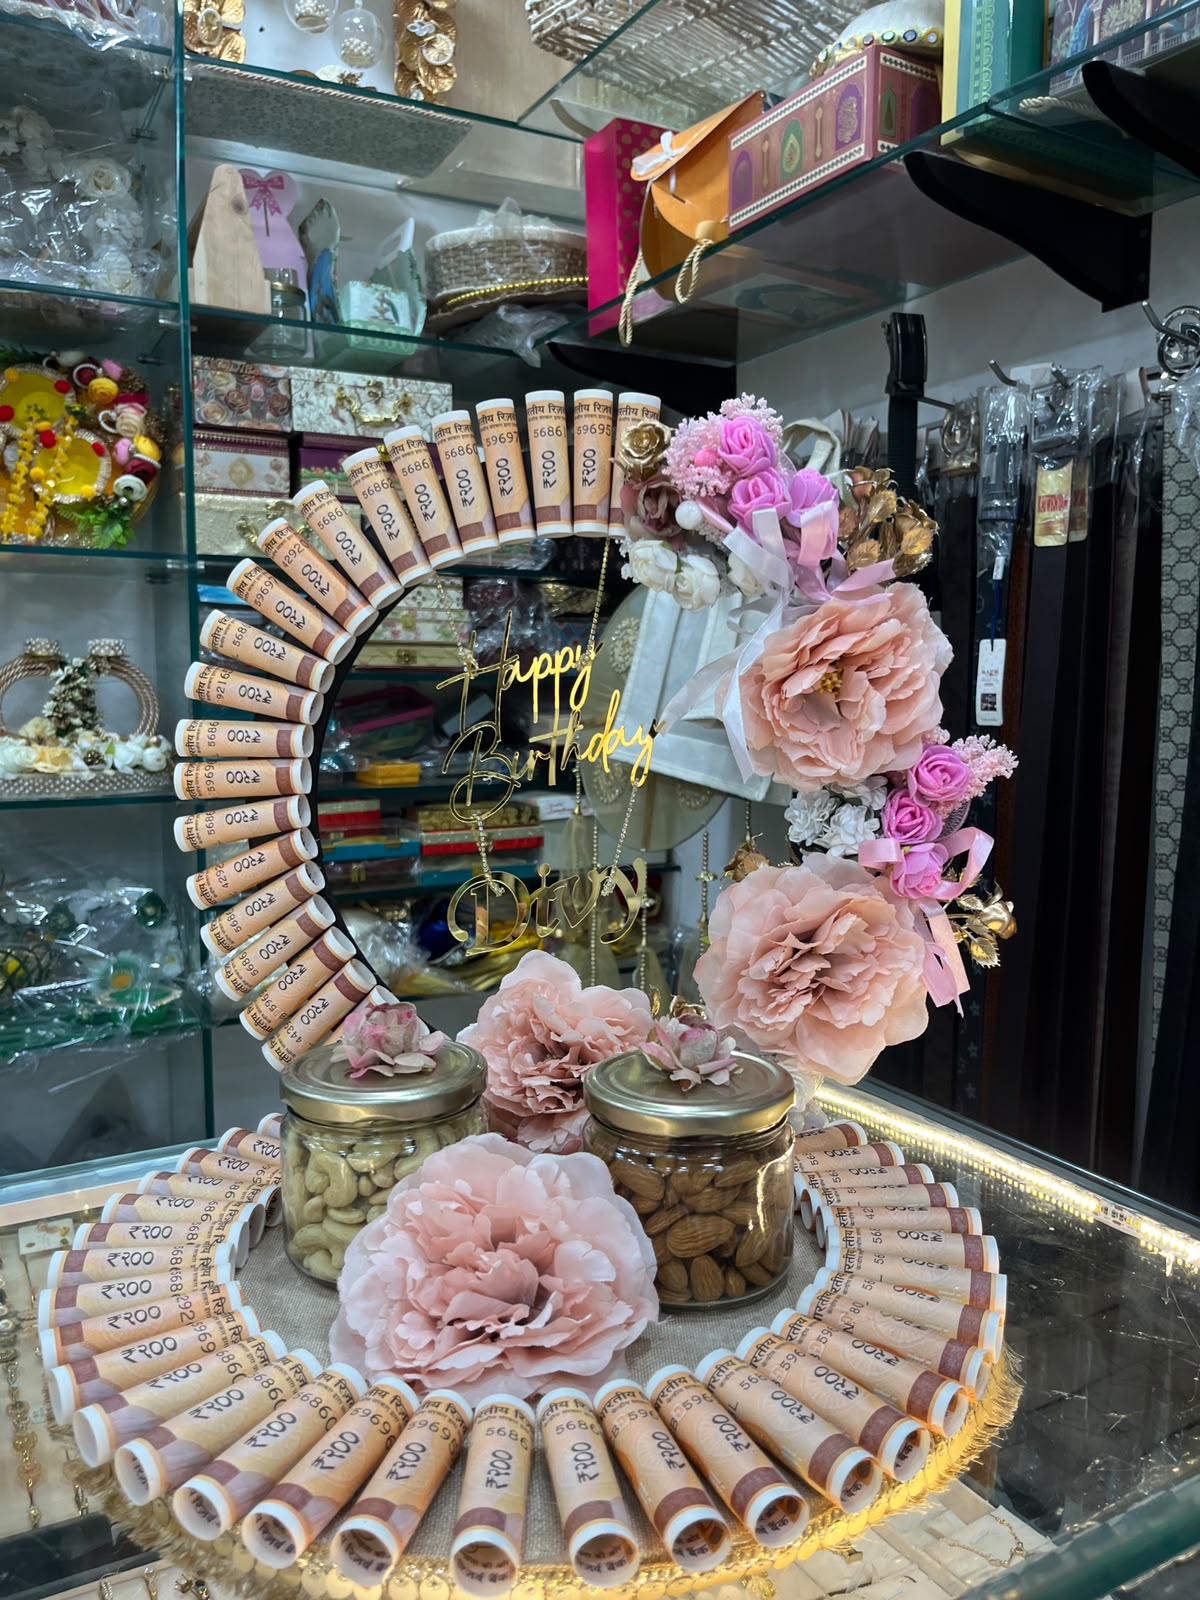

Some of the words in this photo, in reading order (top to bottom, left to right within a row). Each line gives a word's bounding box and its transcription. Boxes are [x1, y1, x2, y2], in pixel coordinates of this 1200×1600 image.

[436, 610, 603, 743] Happy
[442, 689, 667, 824] Birthday
[485, 1426, 528, 1450] 5686
